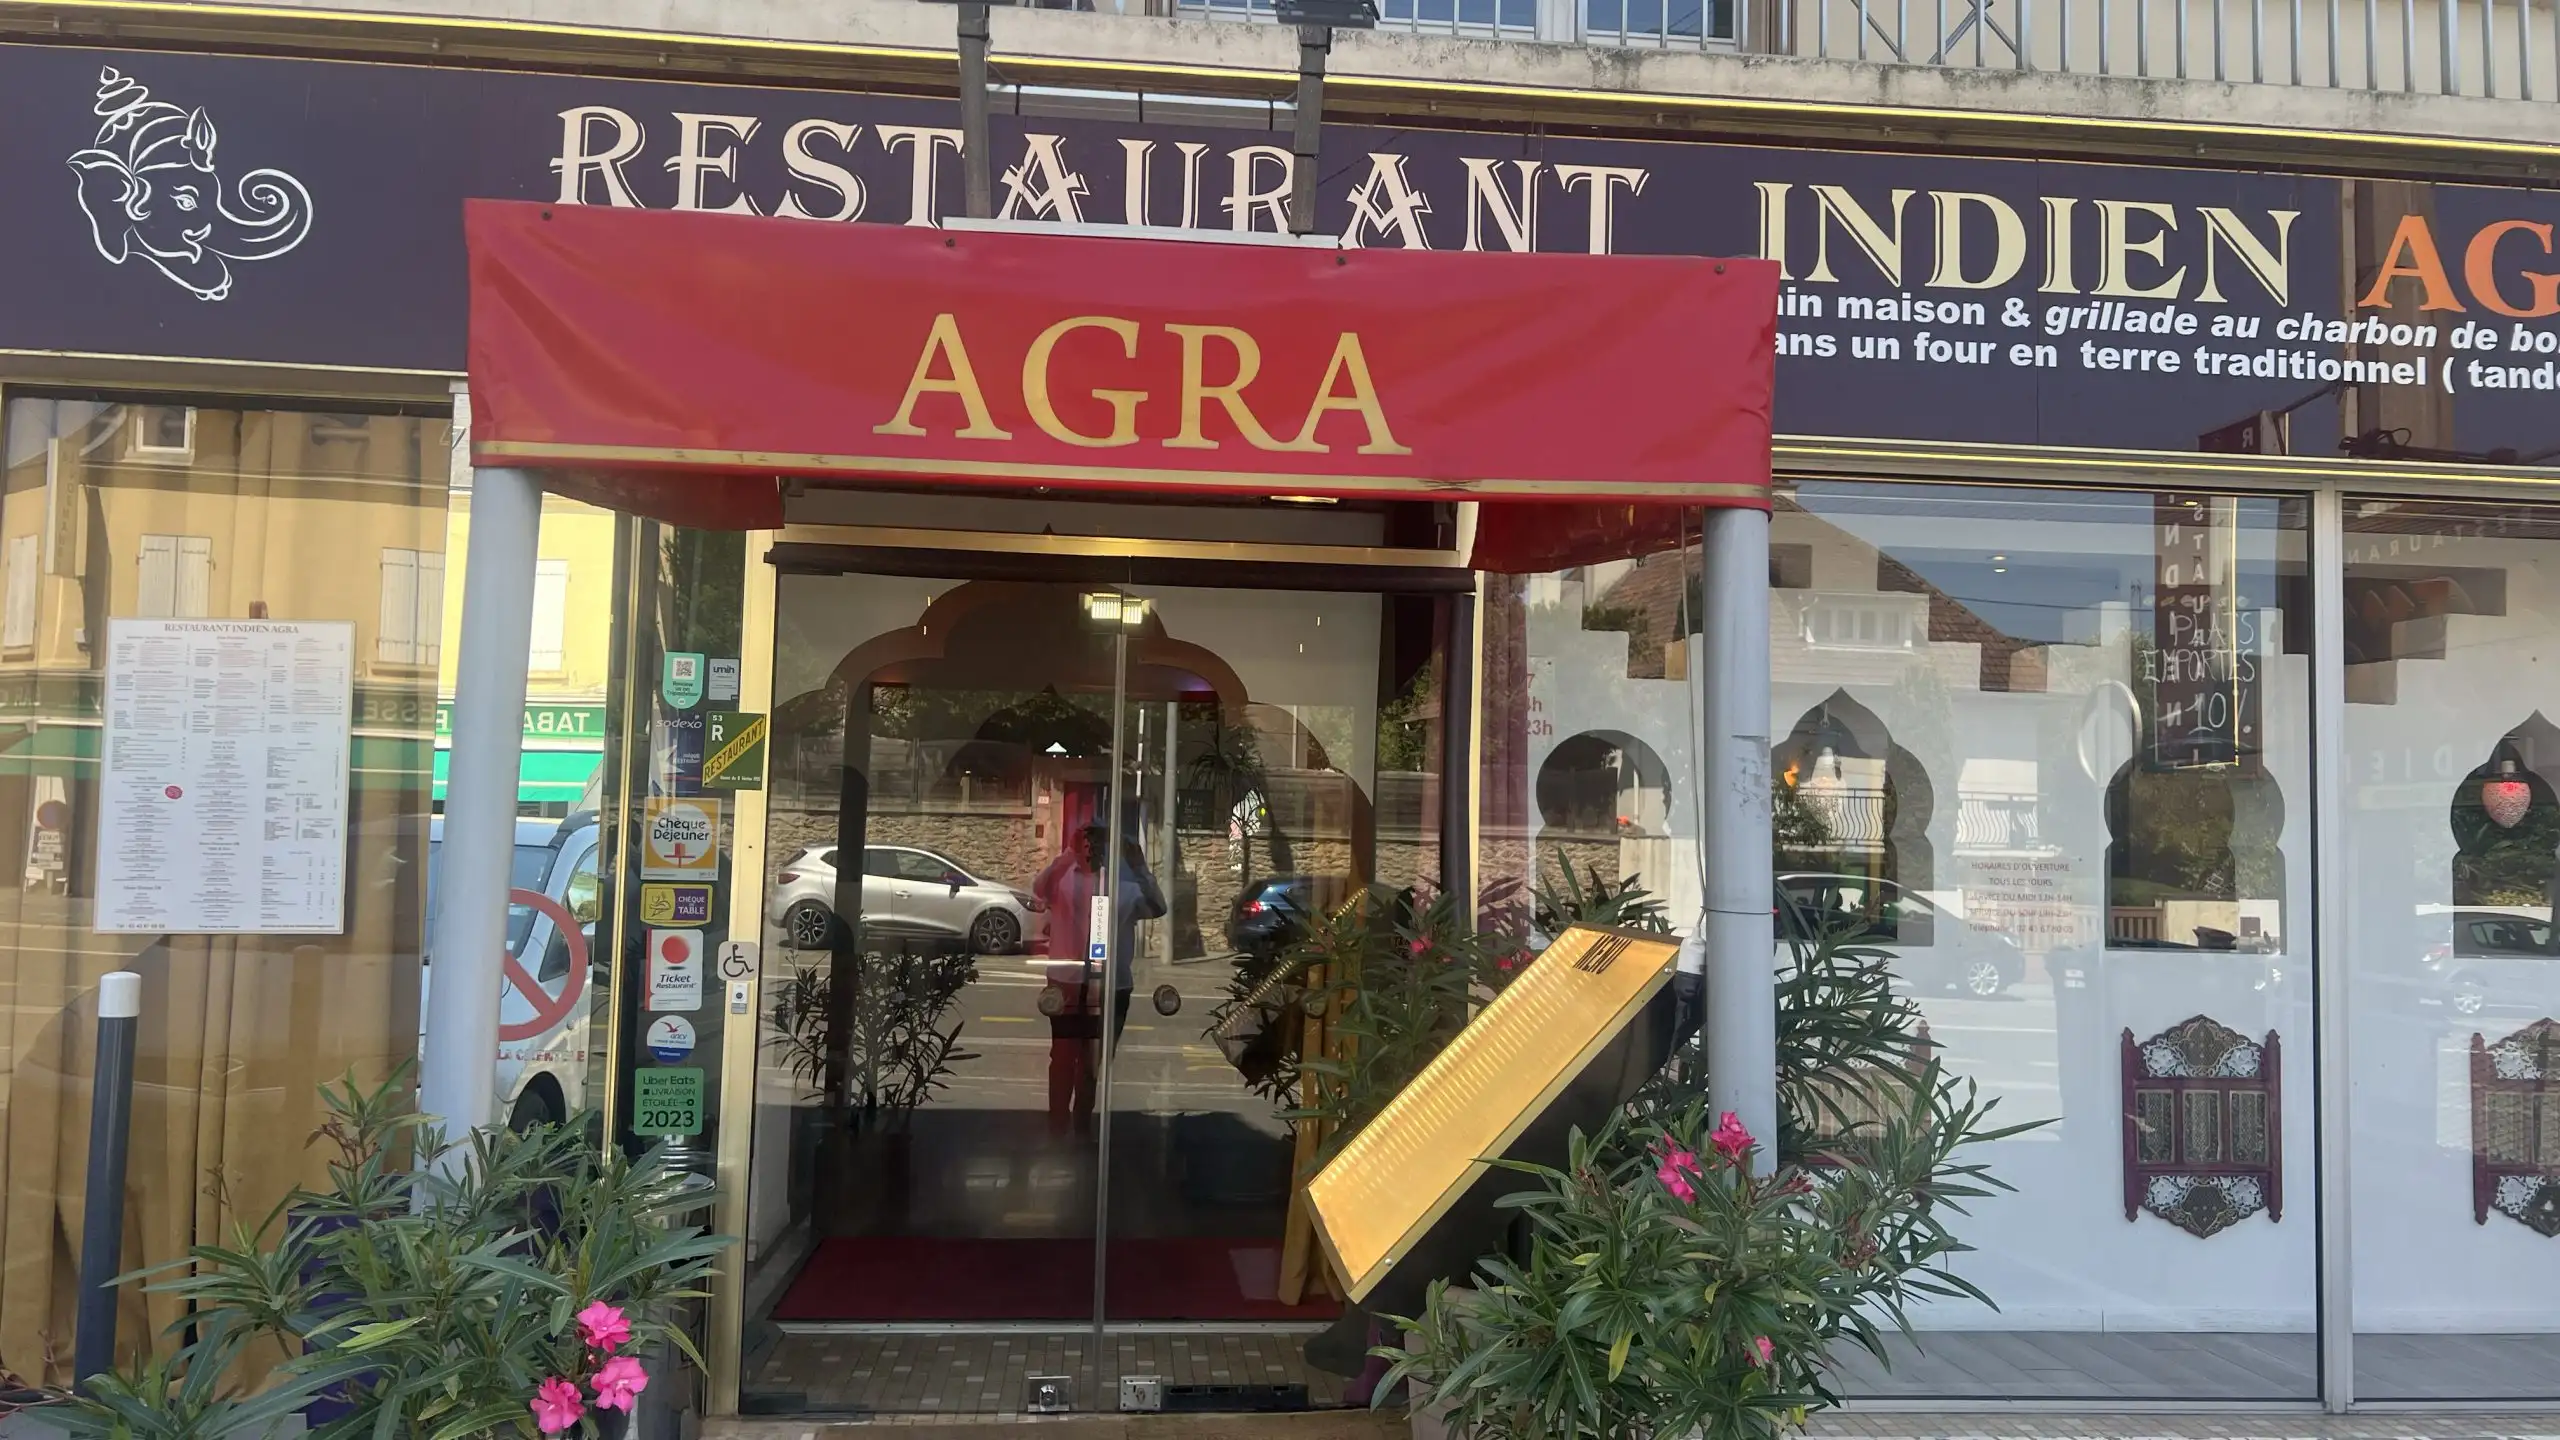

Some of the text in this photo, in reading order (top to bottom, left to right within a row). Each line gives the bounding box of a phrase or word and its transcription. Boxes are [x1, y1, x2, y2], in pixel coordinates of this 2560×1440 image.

[549, 105, 2560, 318] RESTAURANT INDIEN AG
[1837, 292, 1985, 326] maison
[2000, 297, 2032, 328] &
[2044, 300, 2198, 336] grillade
[2210, 313, 2260, 339] au
[2275, 312, 2438, 347] charbon
[2450, 320, 2499, 350] de
[2510, 323, 2560, 354] bo
[1851, 335, 1900, 361] un
[1913, 331, 1997, 365] four
[2009, 343, 2057, 368] en
[2079, 339, 2181, 375] terre
[2193, 344, 2427, 387] traditionnel
[872, 313, 1412, 455] AGRA
[164, 623, 299, 634] RESTAURANT INDIEN AGRA
[713, 664, 735, 674] umih
[2142, 647, 2256, 684] EMPORTES
[655, 716, 703, 730] sodexo
[711, 724, 724, 742] R
[704, 719, 765, 781] RESTAURANT
[658, 817, 706, 831] Chèque
[653, 828, 710, 842] Déjeuner
[678, 906, 705, 915] TABLE
[659, 974, 692, 983] Ticket
[643, 1075, 696, 1086] Uber Eats
[651, 1088, 696, 1096] LIVRAISON
[642, 1110, 695, 1128] 2023
